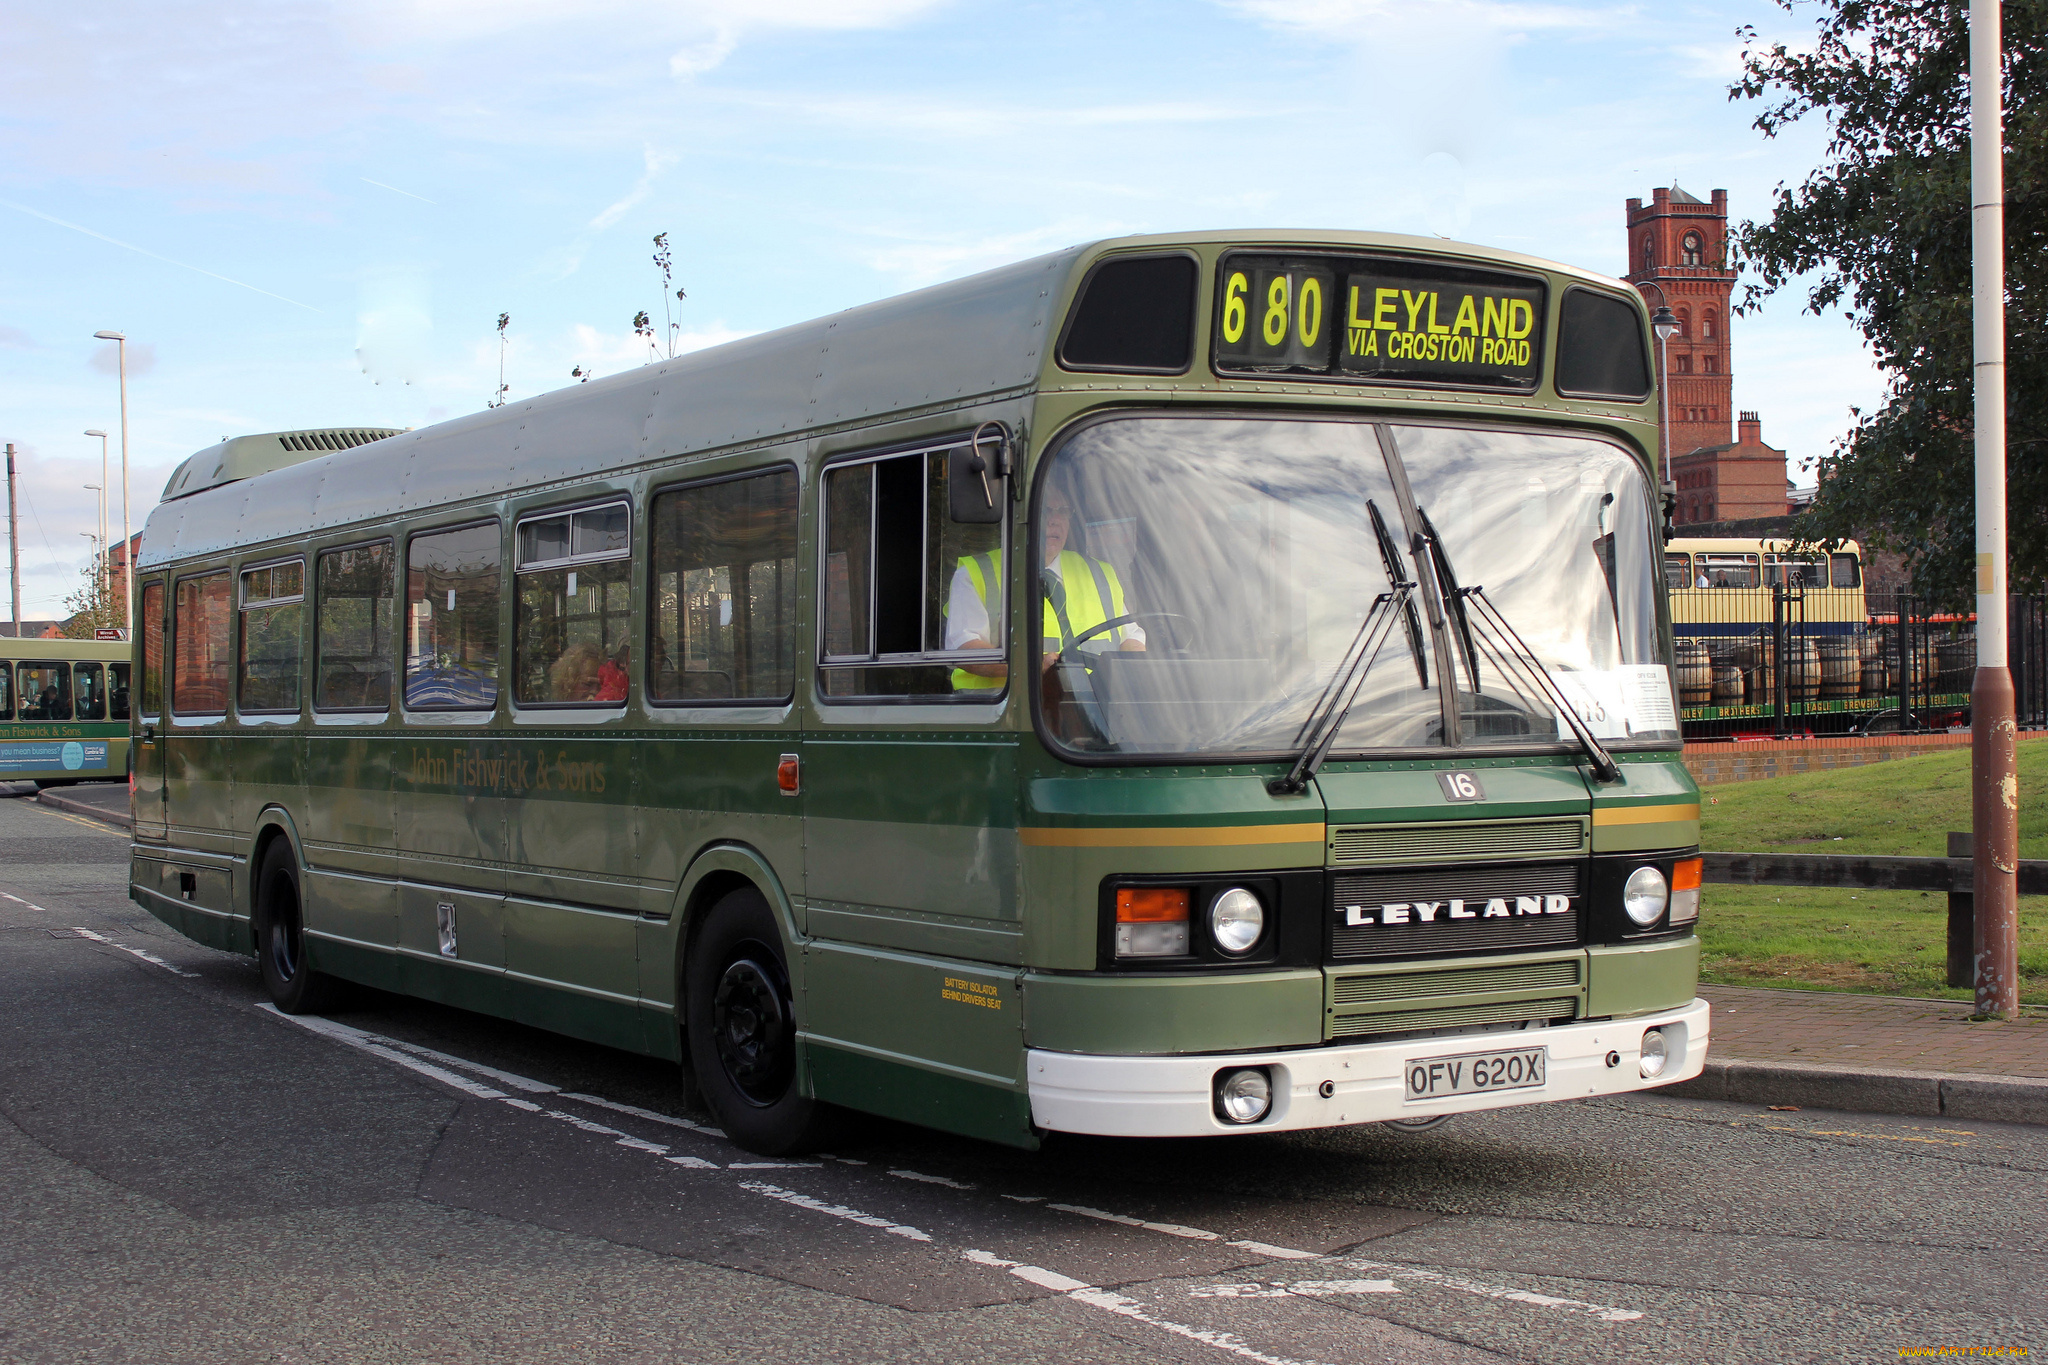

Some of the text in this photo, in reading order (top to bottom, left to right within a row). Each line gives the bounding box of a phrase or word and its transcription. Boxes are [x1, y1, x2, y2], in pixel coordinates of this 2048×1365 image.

[1223, 271, 1322, 348] 680
[1348, 286, 1533, 339] LEYLAND
[1348, 329, 1530, 366] VIA CROSTON ROAD
[12, 726, 49, 737] Fishwick
[52, 726, 59, 736] &
[62, 727, 81, 736] Sons
[32, 747, 60, 755] business?
[407, 747, 606, 793] John Fishwick & Sons
[1446, 773, 1476, 798] 16
[1345, 894, 1570, 926] LEYLAND
[941, 989, 1002, 1010] BEHIND DRIVERS SEAT
[944, 977, 998, 996] BATTERY ISOLATOR
[1411, 1054, 1540, 1094] OFV 620X
